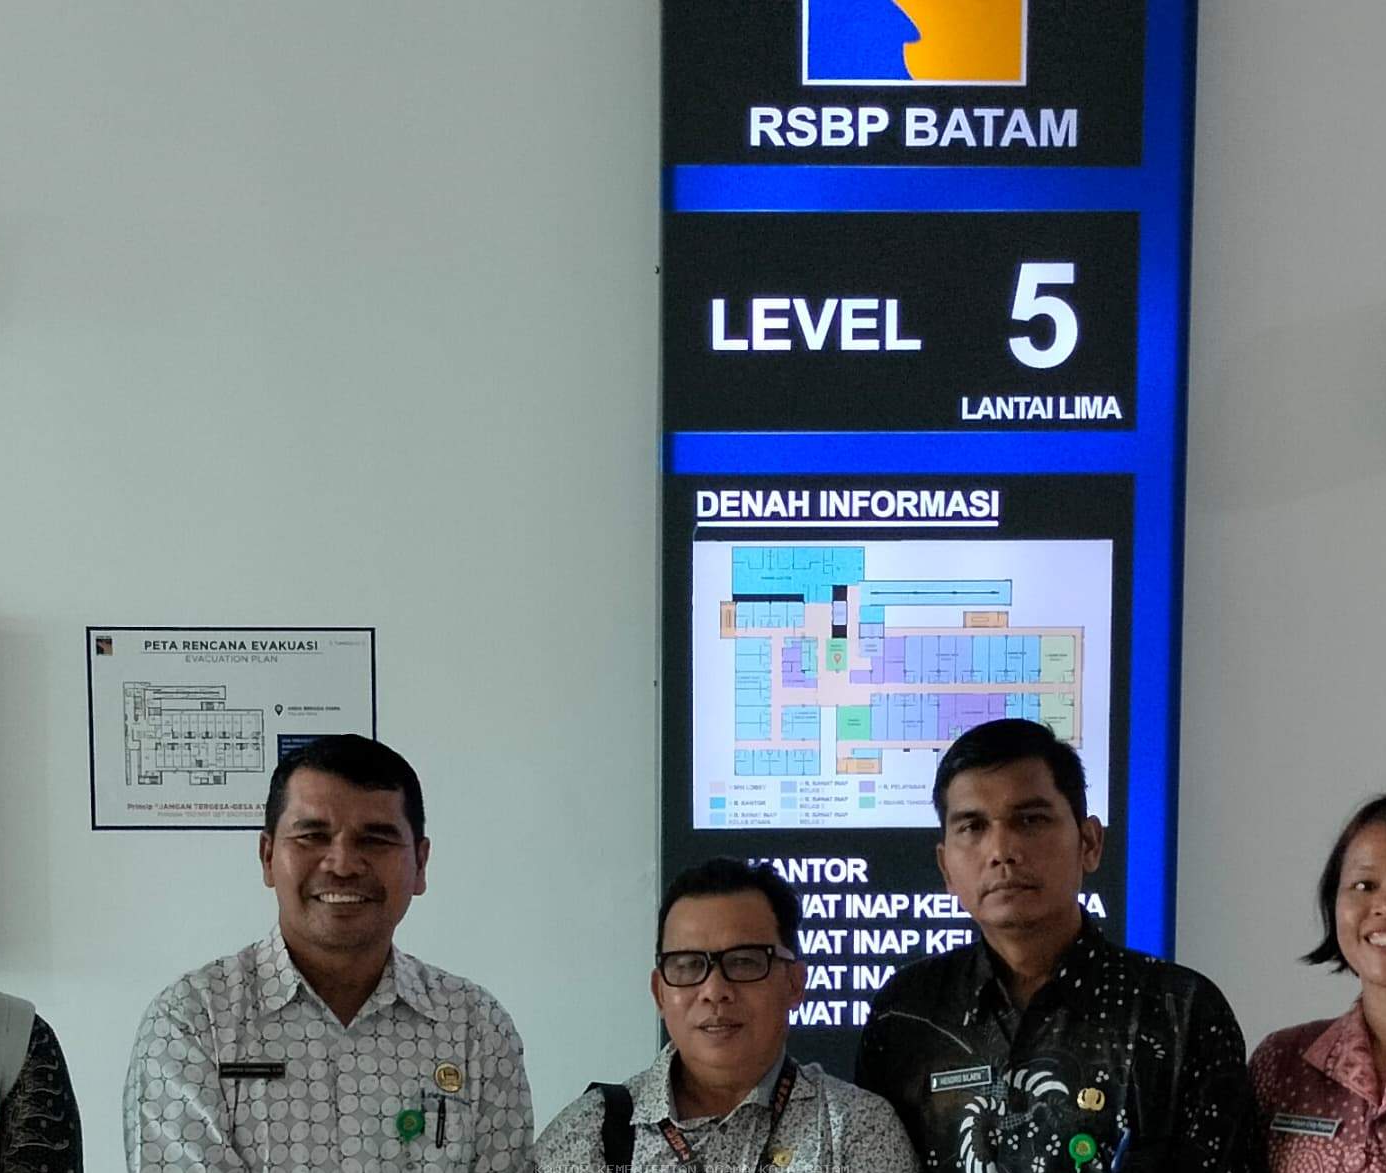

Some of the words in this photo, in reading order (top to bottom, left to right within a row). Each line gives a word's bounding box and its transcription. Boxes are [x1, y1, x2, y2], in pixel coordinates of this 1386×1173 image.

[748, 107, 890, 147] RSBP
[905, 108, 1077, 147] BATAM
[710, 299, 921, 351] LEVEL
[1008, 262, 1079, 370] 5
[961, 397, 1053, 420] LANTAI
[1059, 397, 1122, 420] LIMA
[695, 490, 810, 518] DENAH
[820, 490, 1000, 518] INFORMASI
[144, 640, 178, 650] PETA
[182, 640, 246, 650] RENCANA
[251, 640, 318, 651] EVAKUASI
[185, 655, 249, 664] EVACUATION
[251, 654, 278, 664] PLAN
[748, 857, 869, 883] ANTOR
[845, 894, 910, 919] INAP
[913, 894, 973, 919] KEL
[853, 929, 920, 955] INAP
